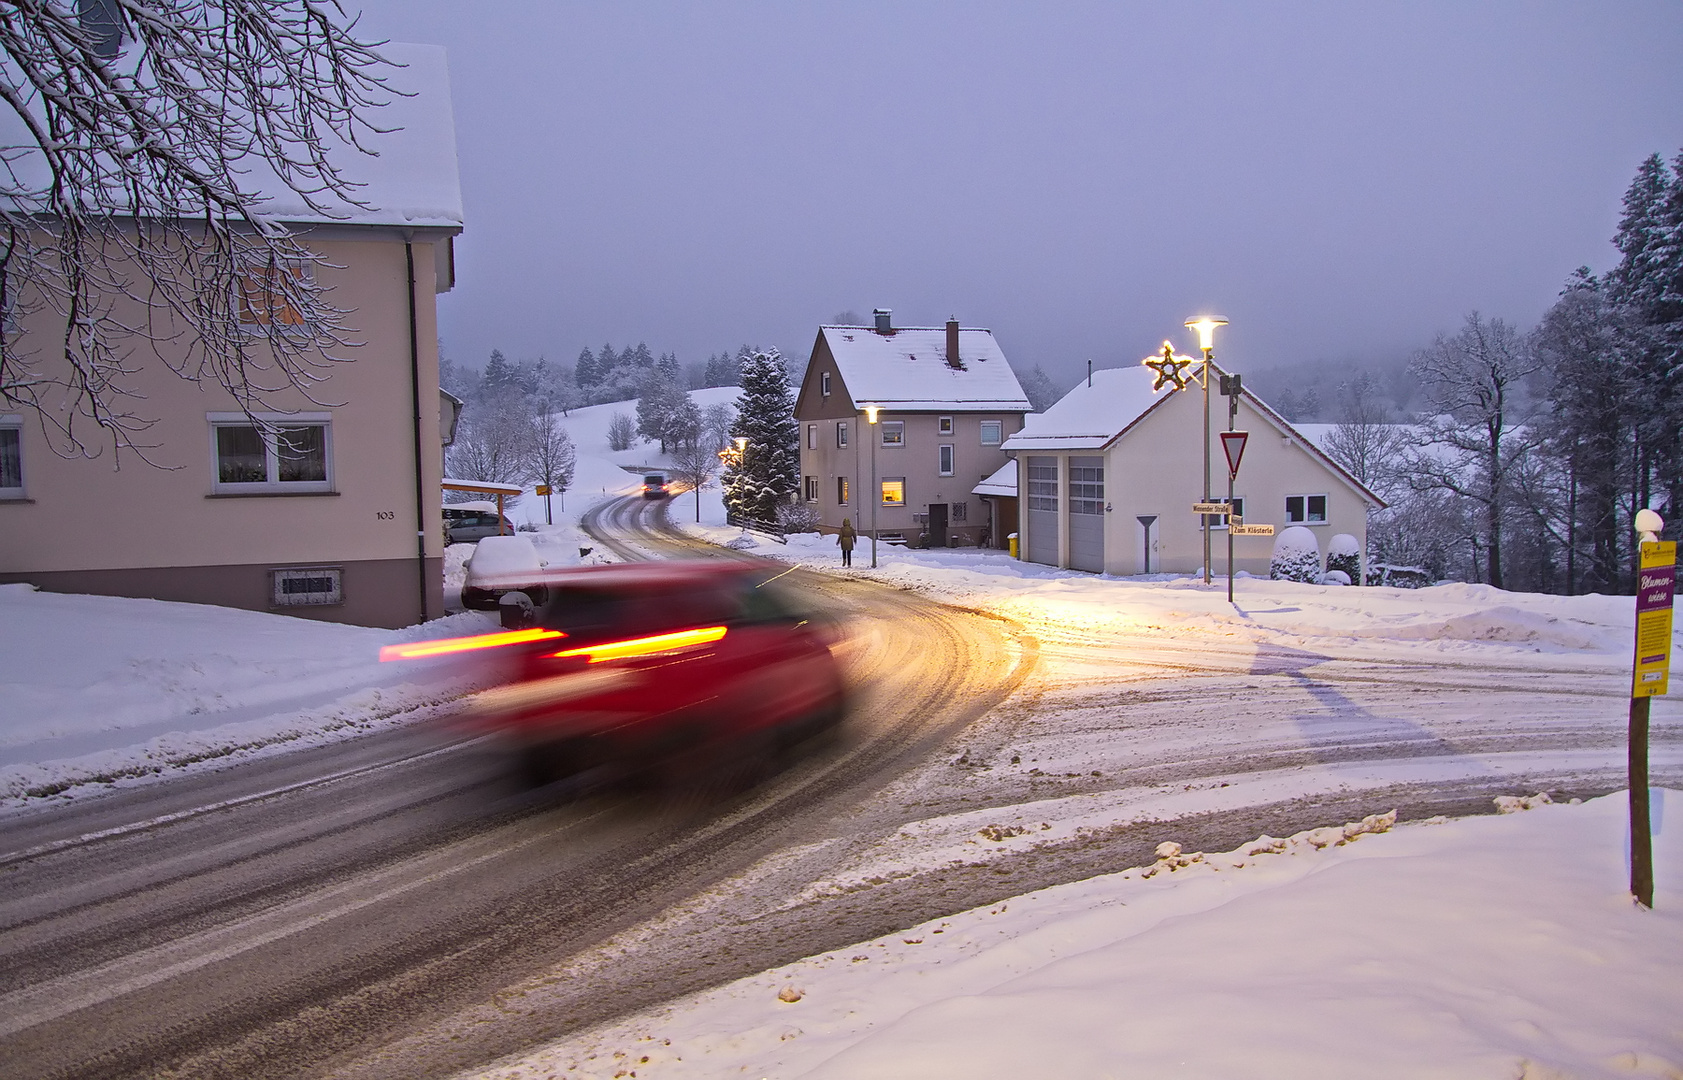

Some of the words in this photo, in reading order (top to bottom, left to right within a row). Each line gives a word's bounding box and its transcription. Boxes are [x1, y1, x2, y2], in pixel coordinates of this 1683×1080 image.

[376, 511, 395, 520] 103
[1234, 526, 1246, 534] Zum
[1641, 575, 1674, 590] Blumen-
[1648, 590, 1667, 603] wiese
